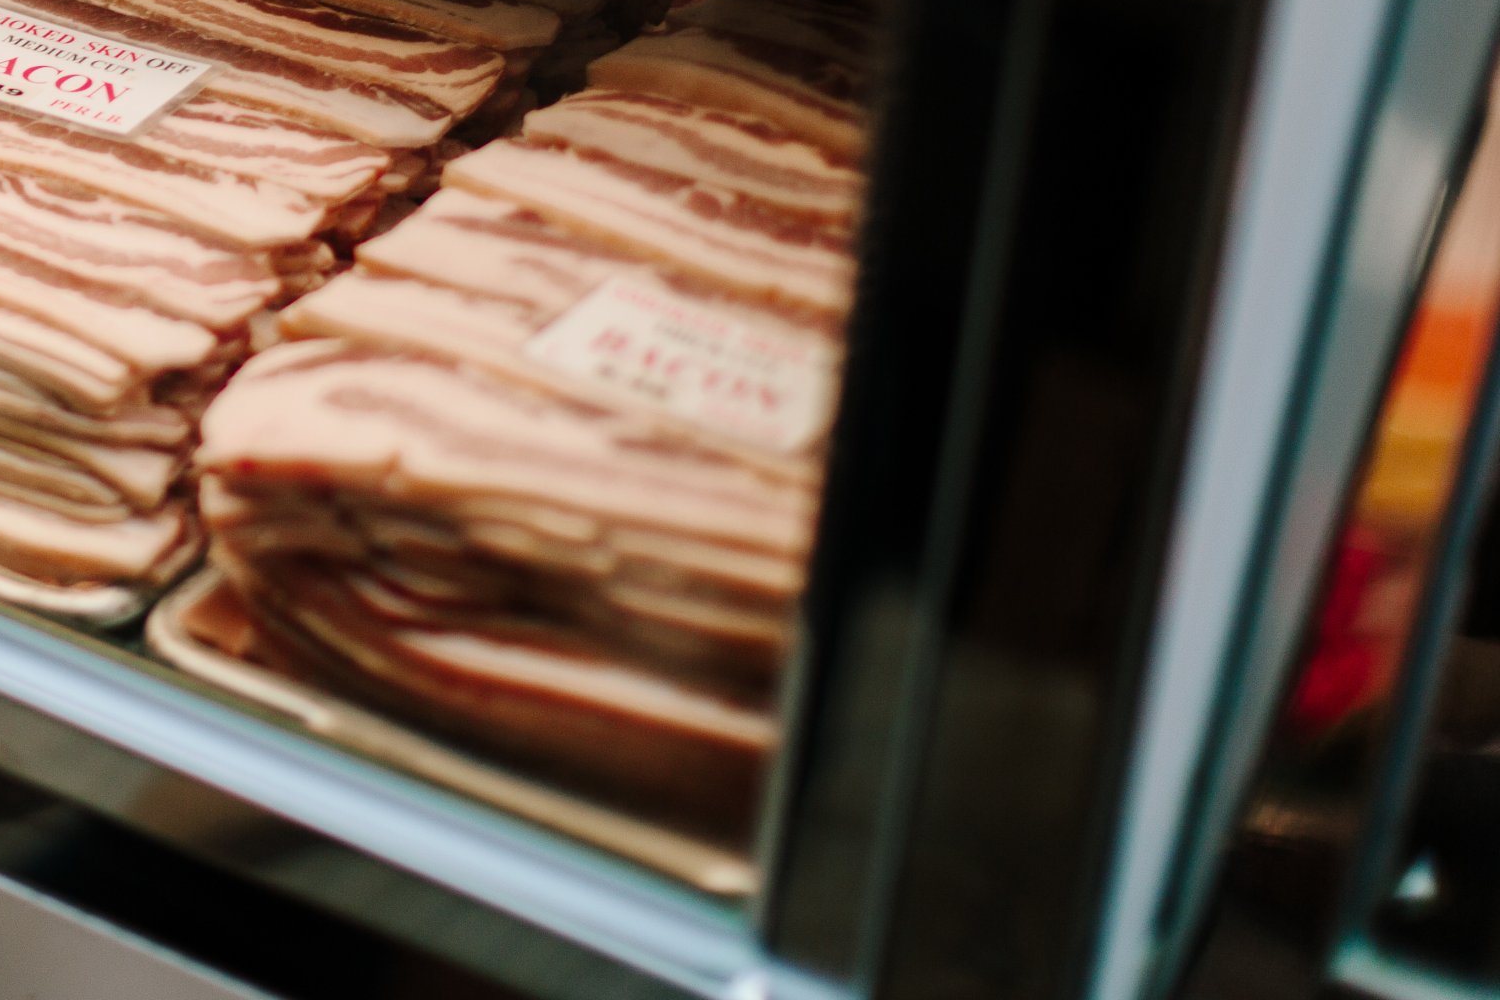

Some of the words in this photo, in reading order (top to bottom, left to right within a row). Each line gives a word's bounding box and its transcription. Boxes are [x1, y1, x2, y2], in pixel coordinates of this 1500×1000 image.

[2, 33, 88, 66] MEDIUM
[89, 57, 136, 78] CUT
[81, 39, 147, 65] SKIN
[145, 56, 199, 77] OFF
[49, 97, 91, 117] PER
